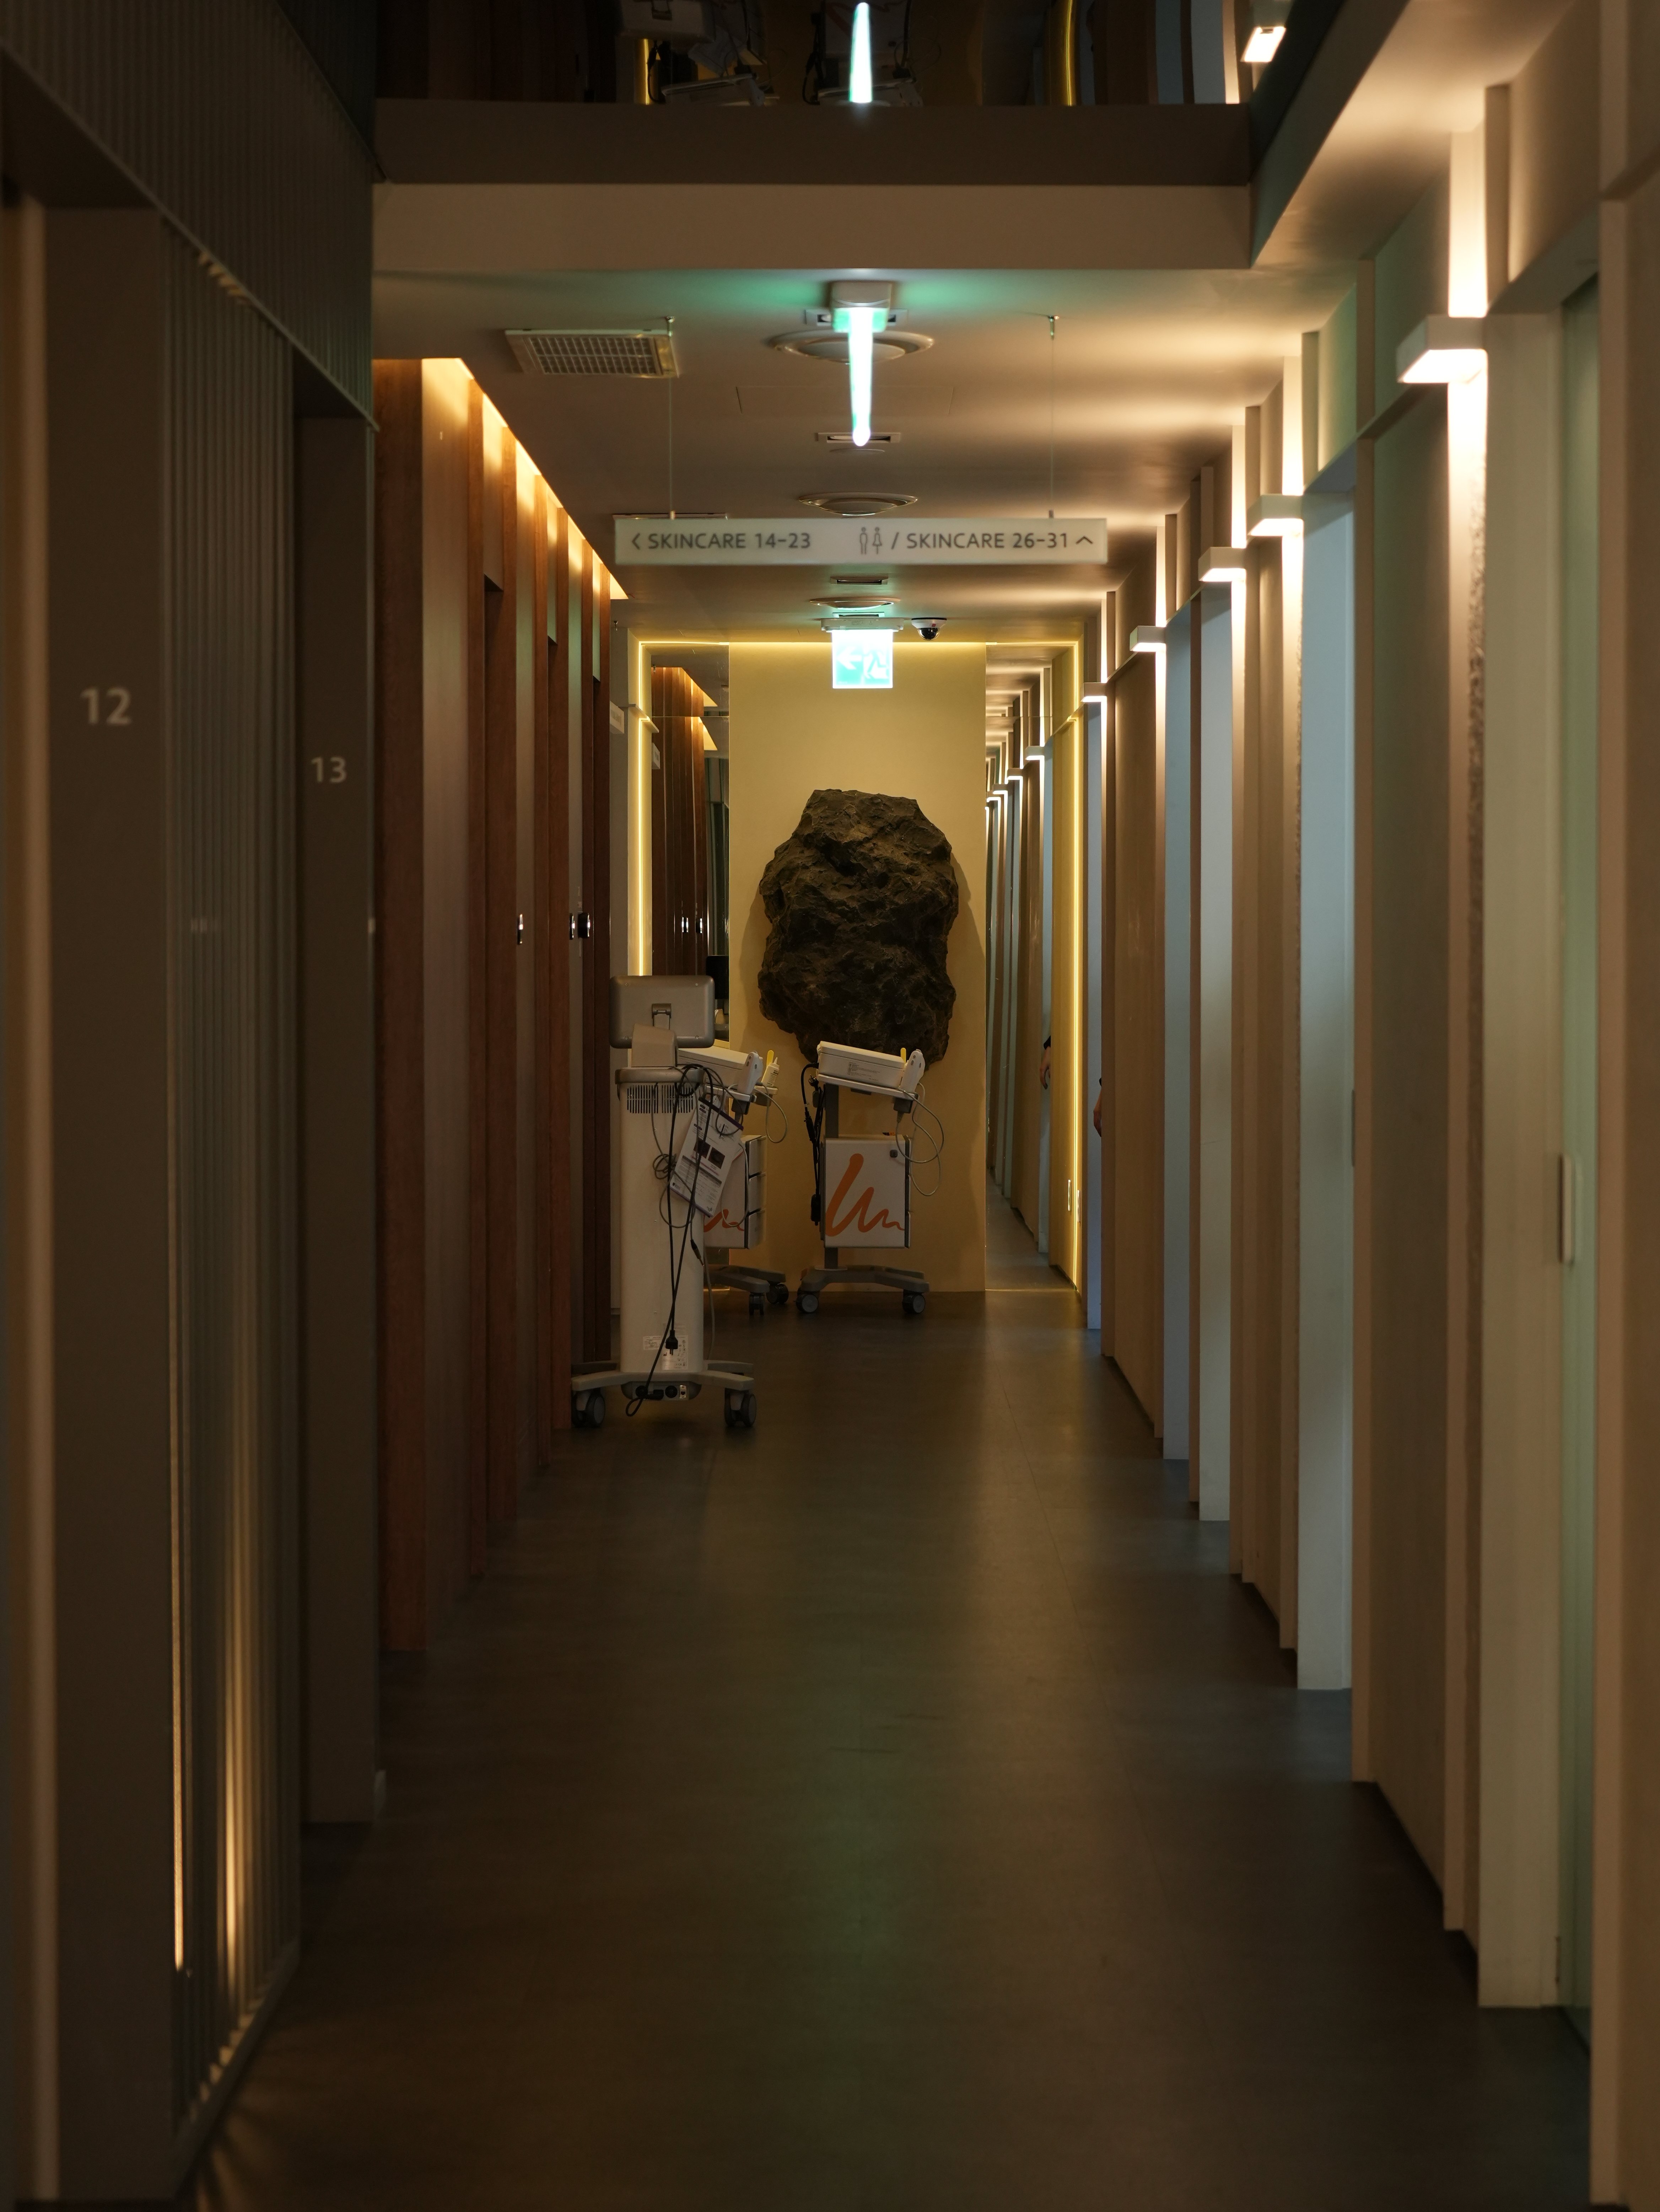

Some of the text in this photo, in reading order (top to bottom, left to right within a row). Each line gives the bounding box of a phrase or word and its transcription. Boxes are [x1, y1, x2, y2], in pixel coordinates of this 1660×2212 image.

[647, 532, 811, 550] SKINCARE 14-23
[906, 532, 1005, 549] SKINCARE
[1012, 532, 1068, 549] 26-31
[81, 686, 132, 726] 12
[311, 756, 347, 783] 13
